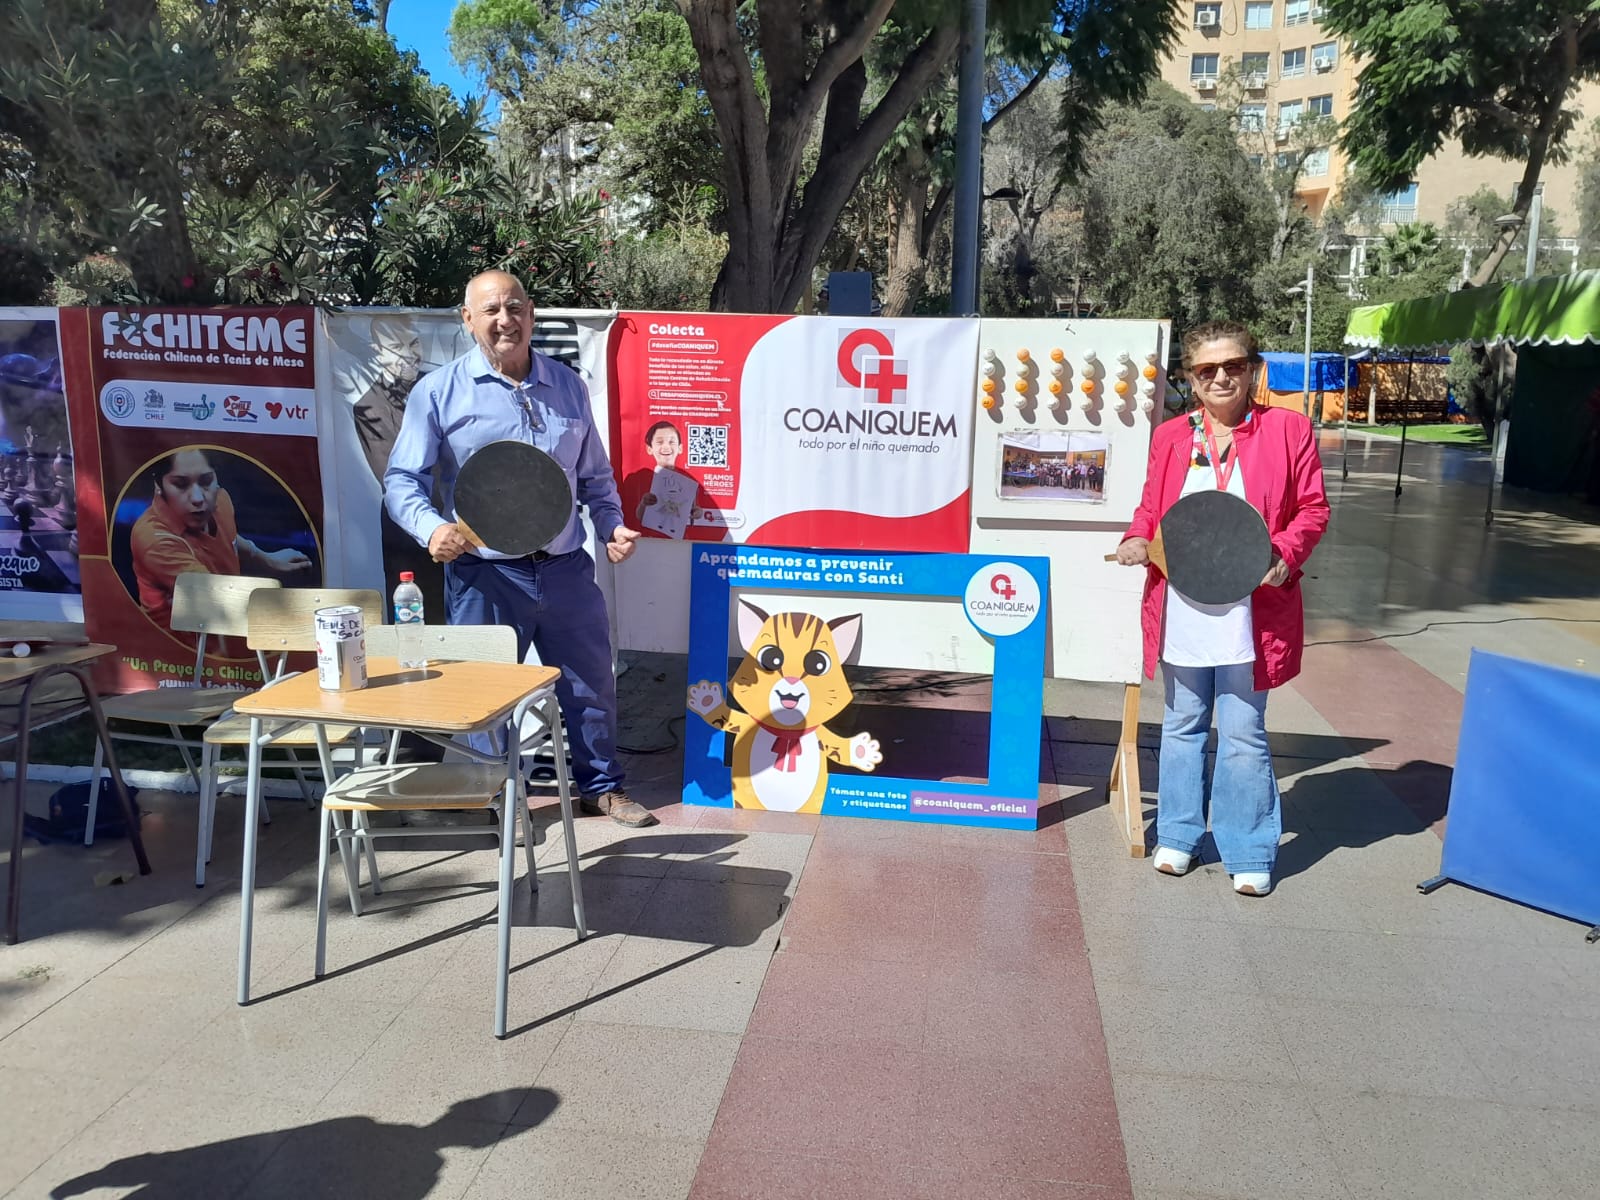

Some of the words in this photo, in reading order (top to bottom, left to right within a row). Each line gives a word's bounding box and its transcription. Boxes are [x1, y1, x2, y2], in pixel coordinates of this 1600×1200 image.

[648, 323, 705, 336] Colecta
[103, 348, 161, 361] Federación
[164, 351, 203, 363] Chilena
[206, 353, 220, 363] de
[223, 354, 251, 365] Tenis
[255, 355, 269, 366] de
[273, 356, 305, 368] Mesa
[144, 412, 165, 420] CHILE
[285, 404, 309, 419] vtr
[784, 407, 958, 438] COANIQUEM
[798, 437, 824, 449] todo
[826, 440, 846, 452] por
[849, 438, 860, 450] el
[862, 440, 885, 451] niño
[887, 441, 940, 454] quemado
[703, 473, 735, 482] SEAMOS
[699, 551, 802, 567] Aprendamos
[806, 559, 818, 568] a
[717, 567, 821, 582] quemaduras
[824, 573, 854, 583] con
[858, 572, 904, 585] Santi
[970, 600, 1035, 613] COANIQUEM
[153, 659, 214, 678] Proyeo
[842, 799, 848, 807] y
[887, 791, 908, 800] foto
[913, 796, 1027, 814] @coaniquem_oficial
